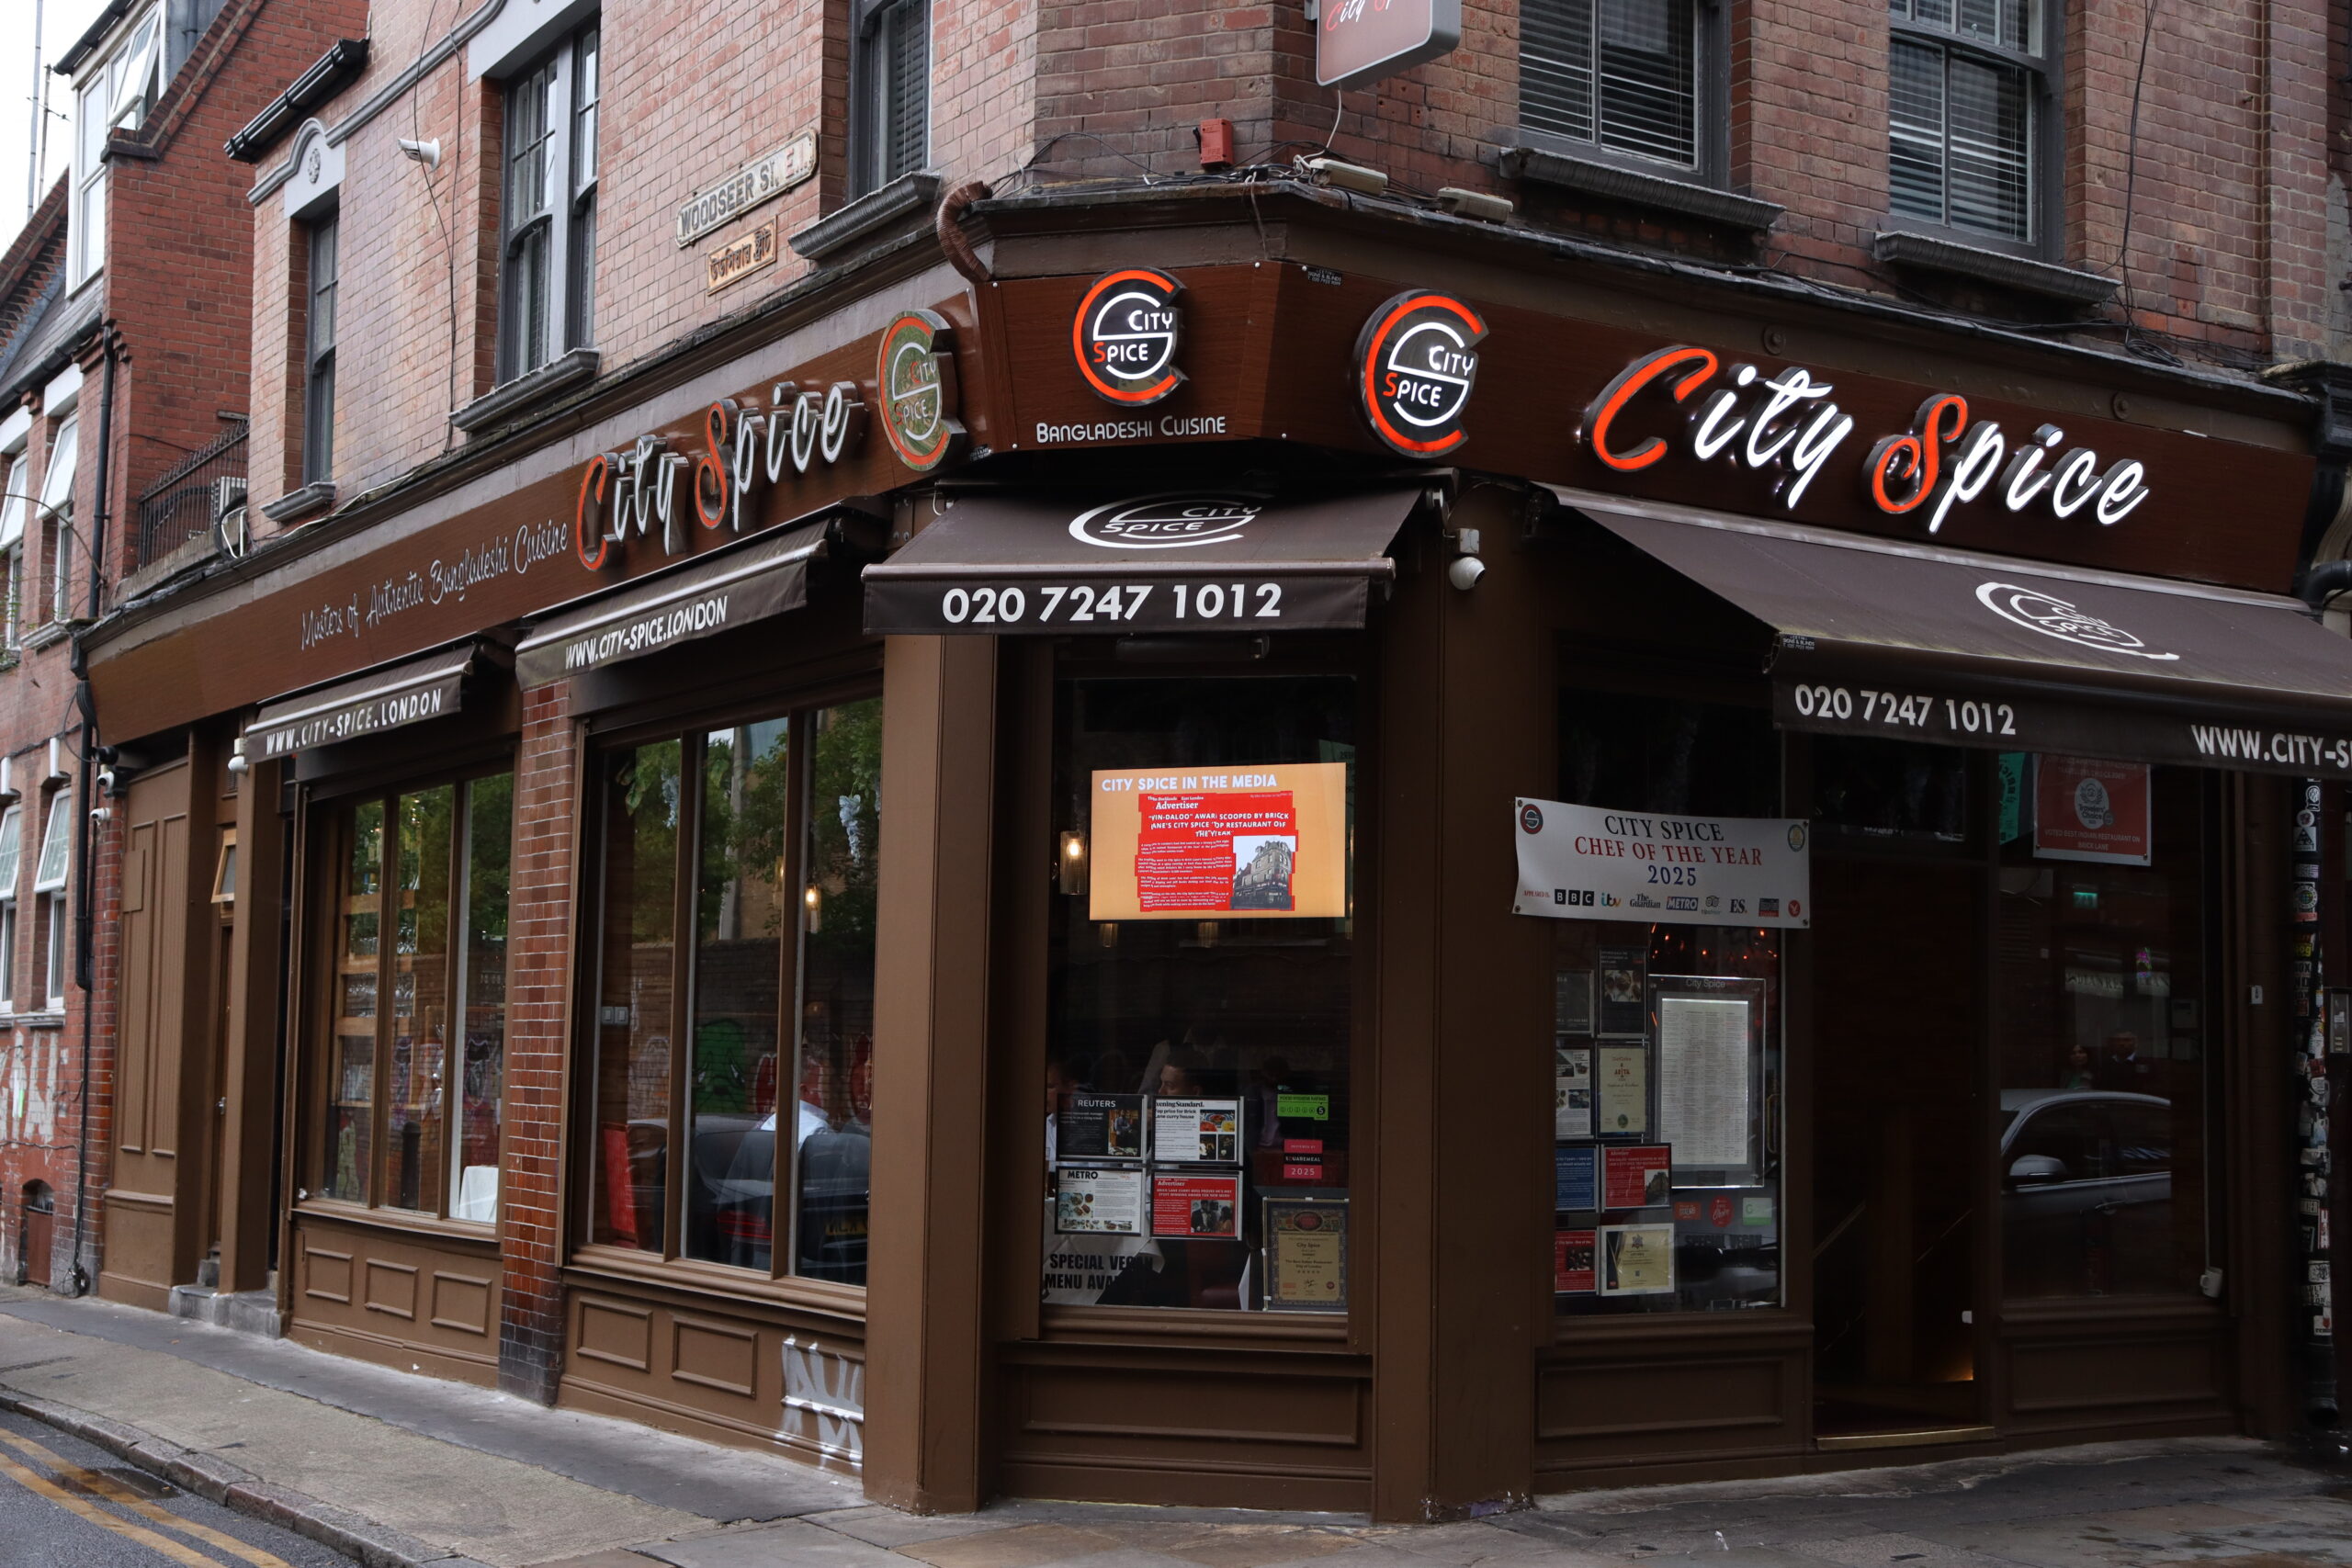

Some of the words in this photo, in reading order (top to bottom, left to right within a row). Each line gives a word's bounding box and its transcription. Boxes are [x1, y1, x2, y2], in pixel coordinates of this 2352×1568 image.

[681, 173, 753, 236] WOODSEER
[1128, 310, 1173, 331] CITY
[1093, 342, 1148, 362] SPICE
[1429, 345, 1474, 376] CITY
[910, 359, 935, 383] CITY
[1383, 372, 1442, 407] SPICE
[895, 399, 927, 425] SPICE
[1036, 420, 1152, 443] BANGLADESHI
[1160, 415, 1226, 435] CUISINE
[1591, 348, 1854, 510] City
[1872, 395, 2150, 535] Spice
[577, 435, 677, 571] City
[695, 384, 853, 533] Spice
[1182, 506, 1262, 518] CITY
[1100, 522, 1204, 534] SPICE
[301, 604, 343, 651] Masters
[347, 592, 359, 638] of
[366, 571, 424, 628] Authentic
[429, 536, 508, 604] Bangladeshi
[514, 519, 568, 574] Cuisine
[943, 587, 1025, 624] 020
[1039, 585, 1153, 623] 7247
[1173, 583, 1282, 618] 1012
[565, 595, 729, 669] WWW.CITY-SPICE.LONDON
[1794, 684, 1852, 720] 020
[1860, 690, 1933, 728] 7247
[1946, 699, 2016, 735] 1012
[266, 688, 442, 756] WWW.CITY-SPICE.LONDON
[1102, 778, 1133, 791] CITY
[1138, 777, 1178, 790] SPICE
[1182, 776, 1197, 789] IN
[1202, 775, 1227, 788] THE
[1232, 774, 1277, 787] MEDIA
[1156, 801, 1198, 810] Advertiser
[1605, 816, 1653, 839] CITY
[1661, 820, 1724, 841] SPICE
[1575, 836, 1625, 857] CHEF
[1633, 842, 1656, 861] OF
[1662, 845, 1705, 863] THE
[1711, 847, 1762, 865] YEAR
[1648, 865, 1697, 887] 2025
[1555, 889, 1595, 907] BBC
[1601, 892, 1622, 908] itv
[1630, 899, 1661, 908] Guardian
[1636, 893, 1650, 901] The
[1667, 897, 1698, 910] METRO
[1686, 978, 1702, 988] City
[1704, 979, 1725, 988] Spice
[1078, 1100, 1116, 1108] REUTERS
[1068, 1170, 1098, 1179] METRO
[1050, 1254, 1104, 1269] SPECIAL
[1045, 1273, 1082, 1290] MENU
